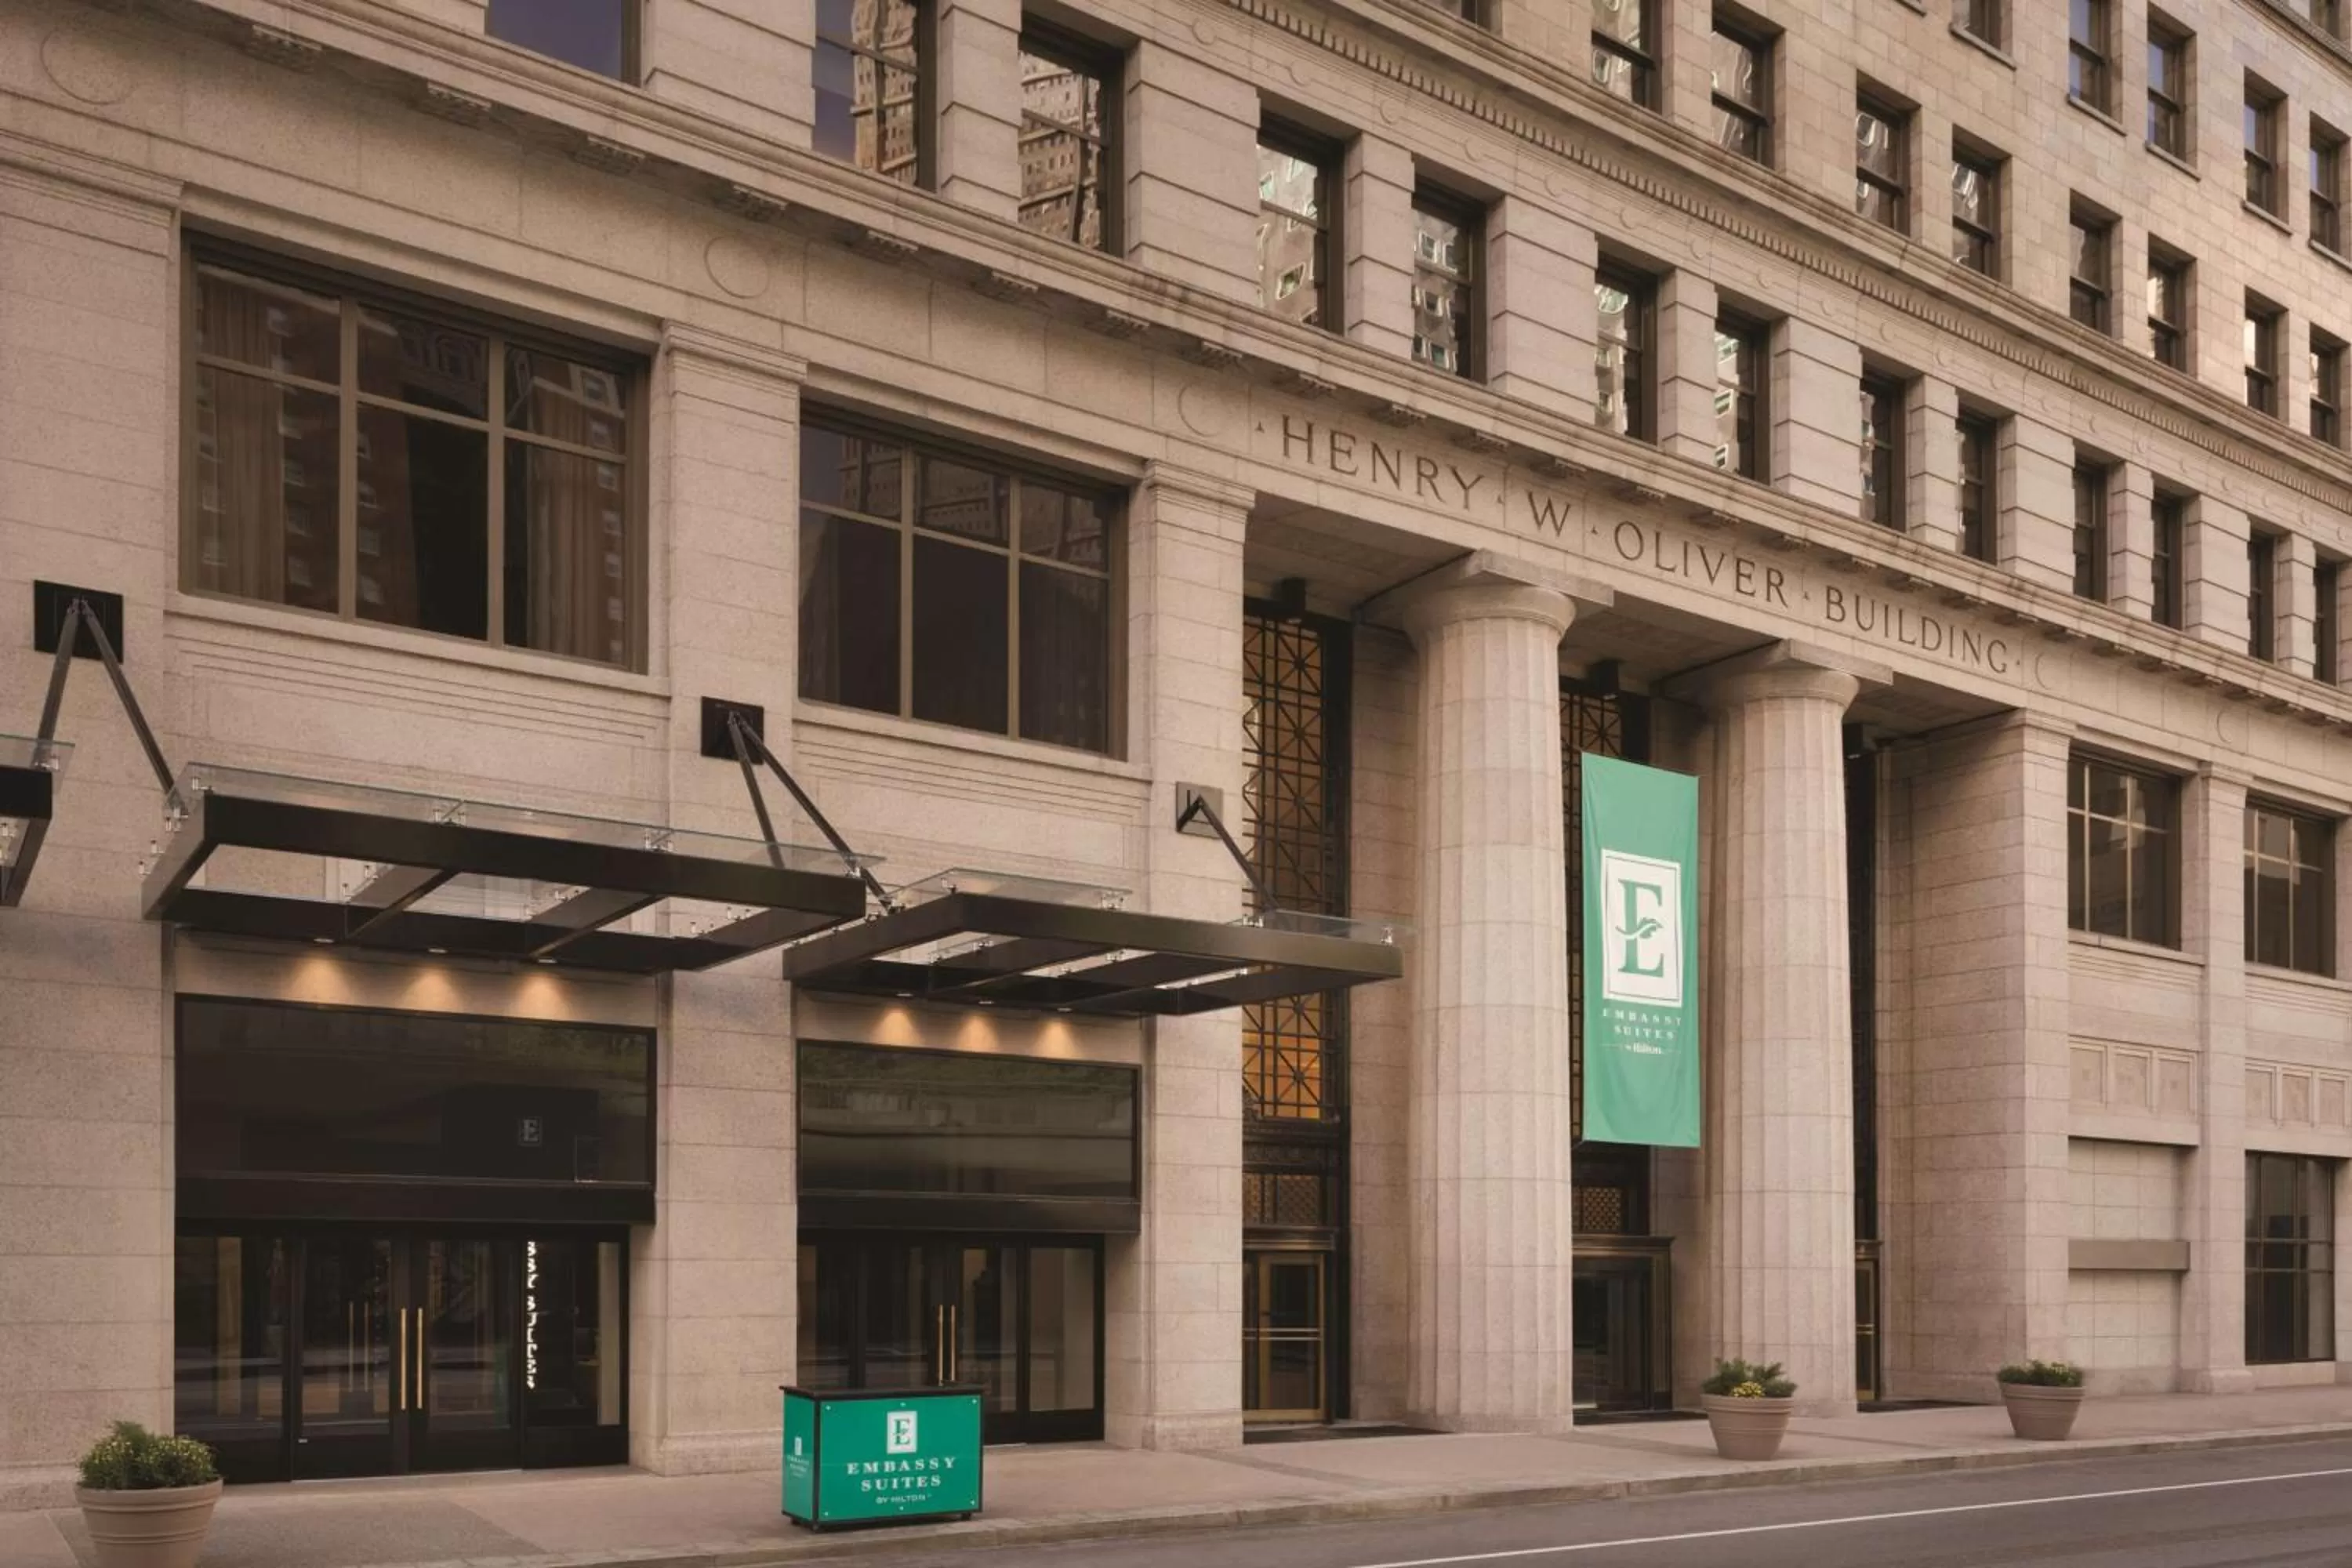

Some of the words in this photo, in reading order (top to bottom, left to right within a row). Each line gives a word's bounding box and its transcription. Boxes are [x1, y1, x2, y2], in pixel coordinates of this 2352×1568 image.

[1281, 413, 1484, 511] HENRY
[1526, 490, 1571, 537] W
[1613, 520, 1788, 608] OLIVER
[1826, 585, 2008, 673] BUILDING
[1615, 878, 1664, 978] E
[894, 1418, 910, 1445] E
[847, 1457, 956, 1475] EMBASSY
[861, 1475, 941, 1491] SUITES
